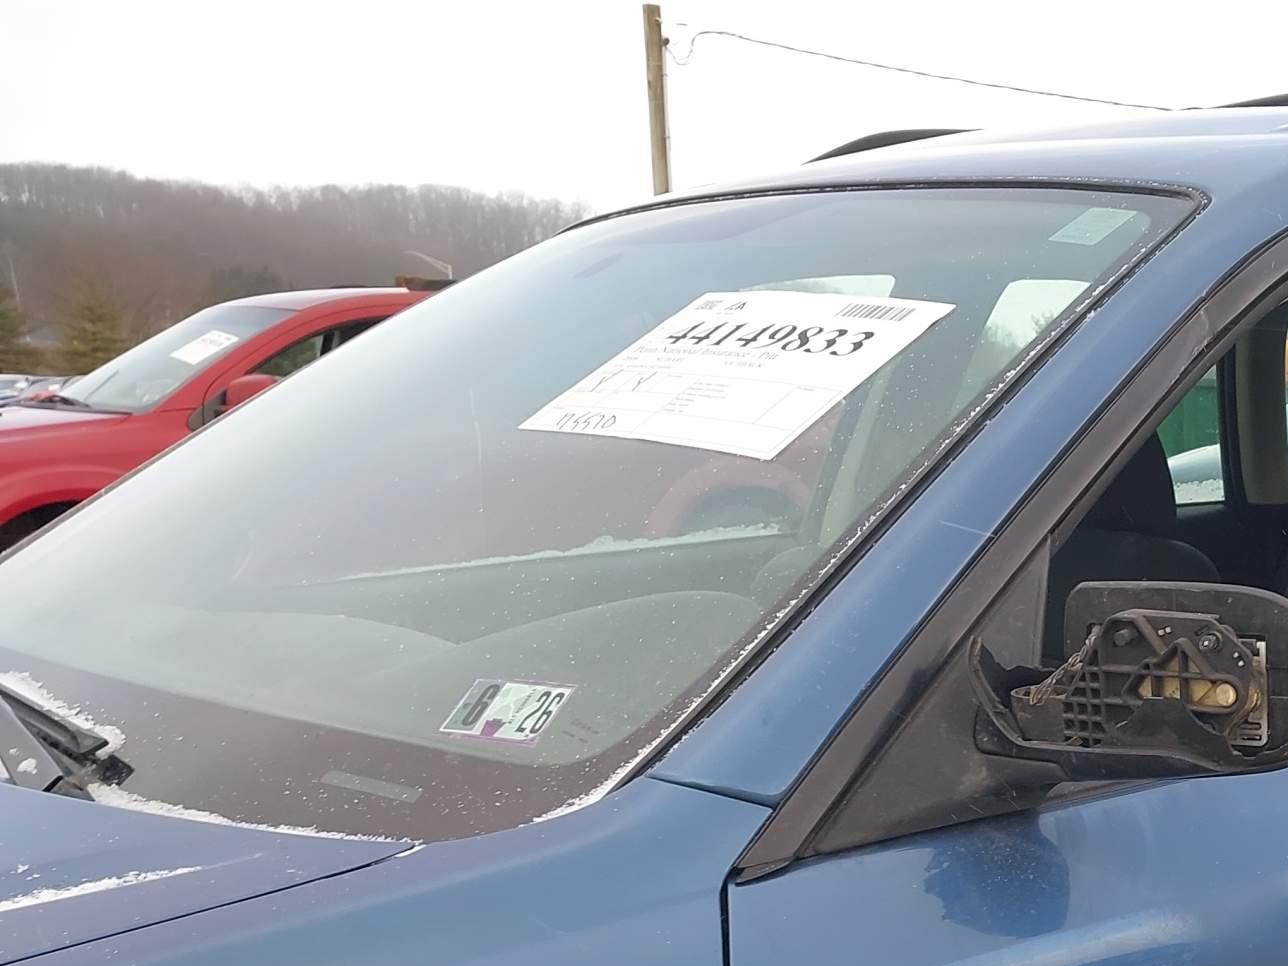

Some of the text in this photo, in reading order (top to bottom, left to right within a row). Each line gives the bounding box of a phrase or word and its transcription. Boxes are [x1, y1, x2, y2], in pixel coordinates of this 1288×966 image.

[666, 321, 875, 357] 44149833
[462, 684, 501, 726] 6
[514, 690, 566, 734] 26
